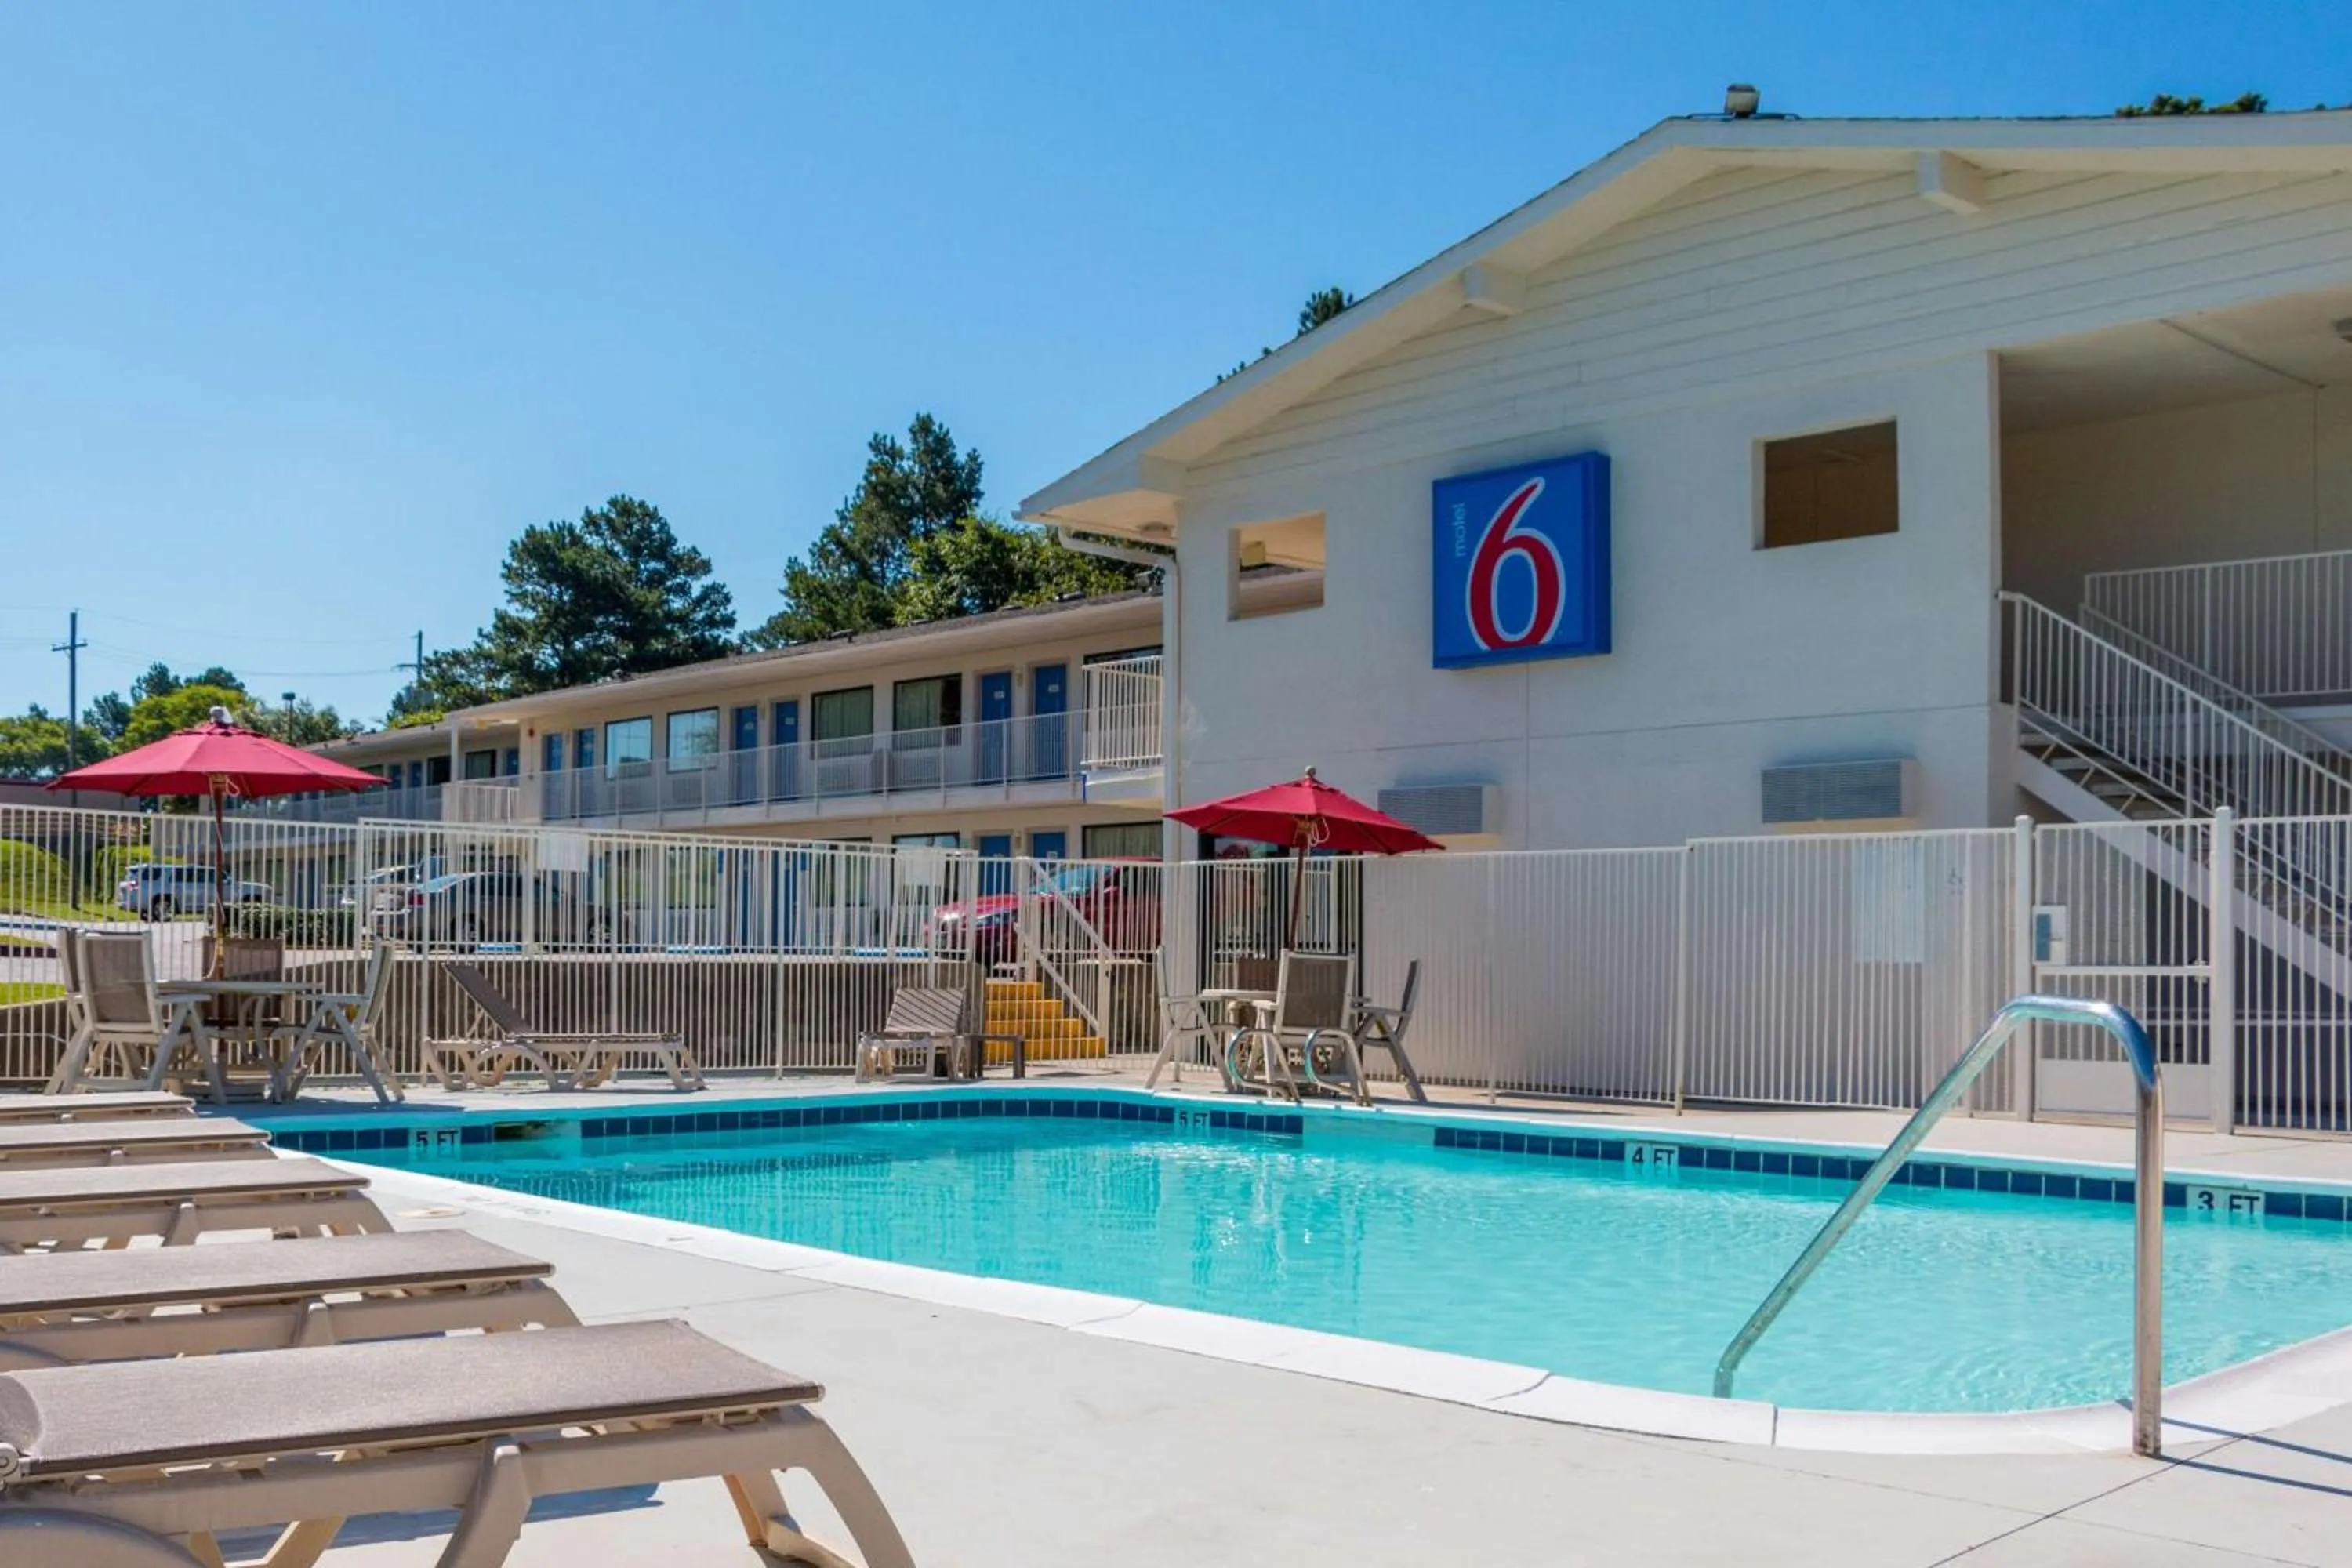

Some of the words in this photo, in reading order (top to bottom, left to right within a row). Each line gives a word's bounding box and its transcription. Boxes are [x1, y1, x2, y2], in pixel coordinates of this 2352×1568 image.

[1451, 502, 1467, 557] motel
[1465, 476, 1566, 651] 6
[1178, 1110, 1188, 1127] 5
[1192, 1112, 1208, 1127] FT
[416, 1131, 428, 1147] 5
[437, 1130, 458, 1145] FT
[1632, 1146, 1644, 1163] 4
[1653, 1149, 1675, 1166] FT
[2198, 1191, 2215, 1211] 3
[2228, 1194, 2260, 1214] FT
